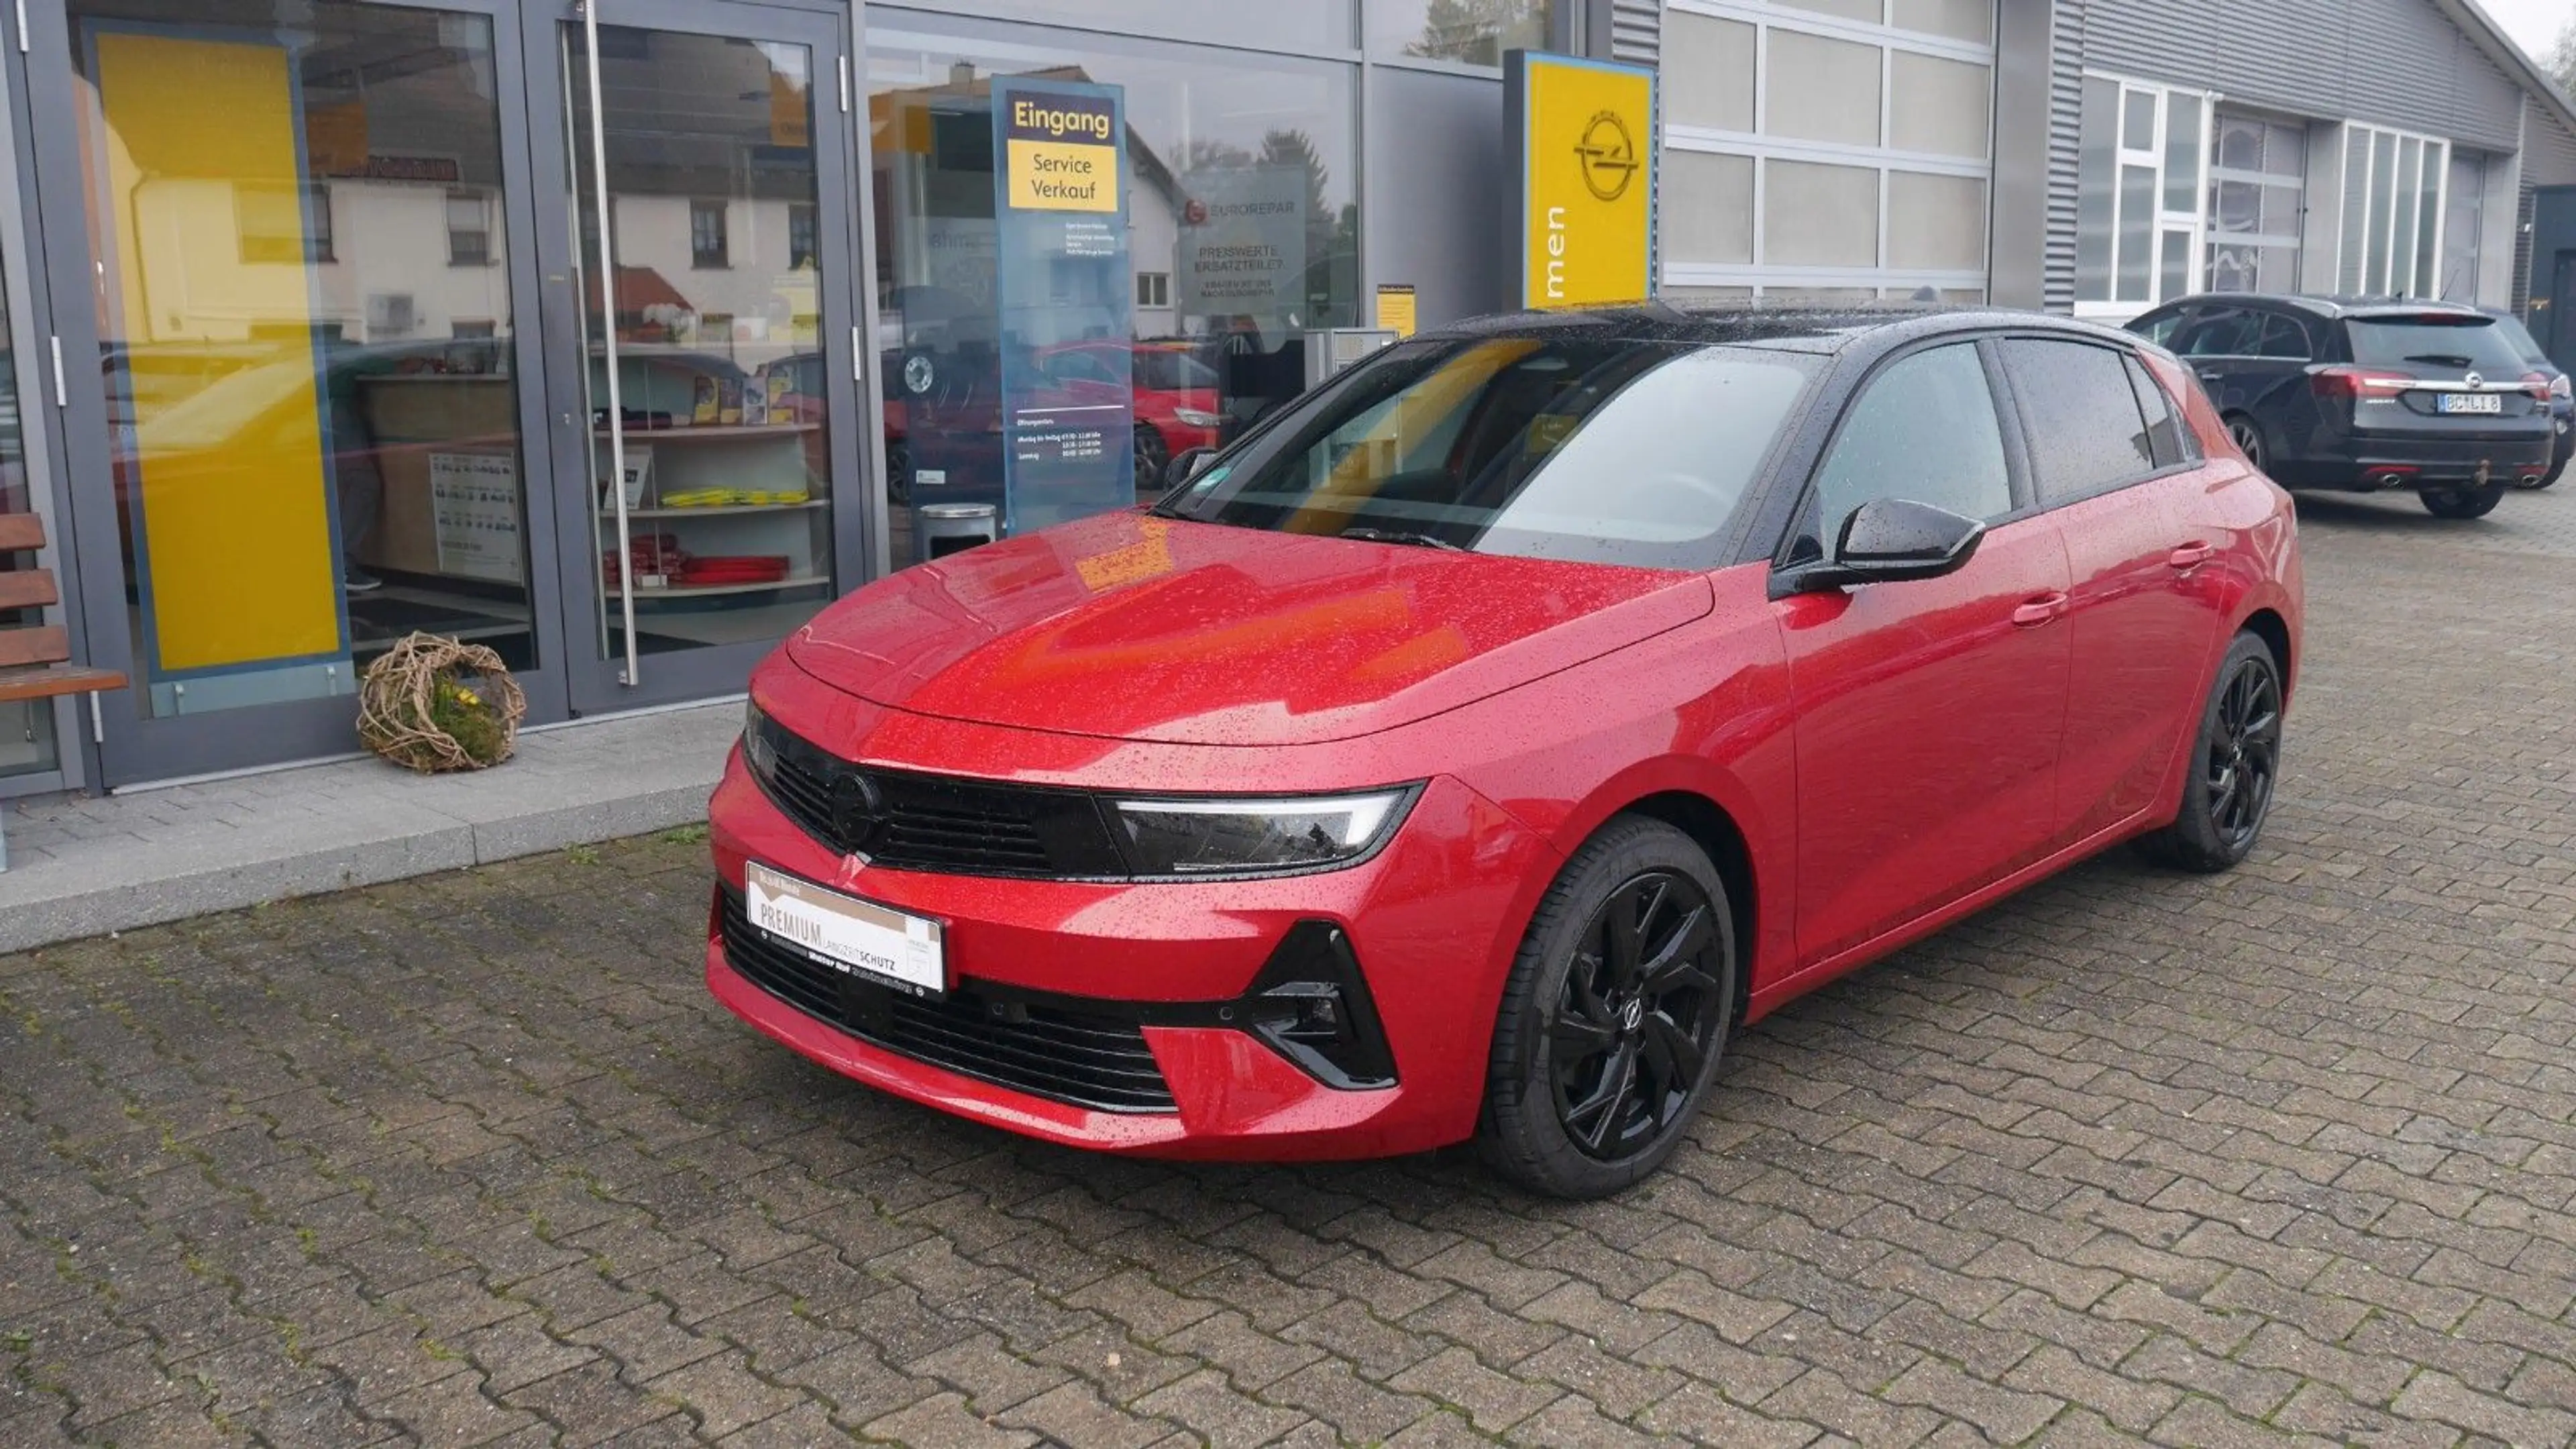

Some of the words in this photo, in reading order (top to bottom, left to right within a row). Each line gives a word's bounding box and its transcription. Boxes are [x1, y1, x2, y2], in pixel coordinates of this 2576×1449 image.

[1014, 101, 1109, 139] Eingang
[1033, 154, 1092, 174] Service
[1031, 180, 1095, 200] Verkauf
[1210, 201, 1295, 217] EUROREPAR
[761, 903, 822, 948] PREMIUM
